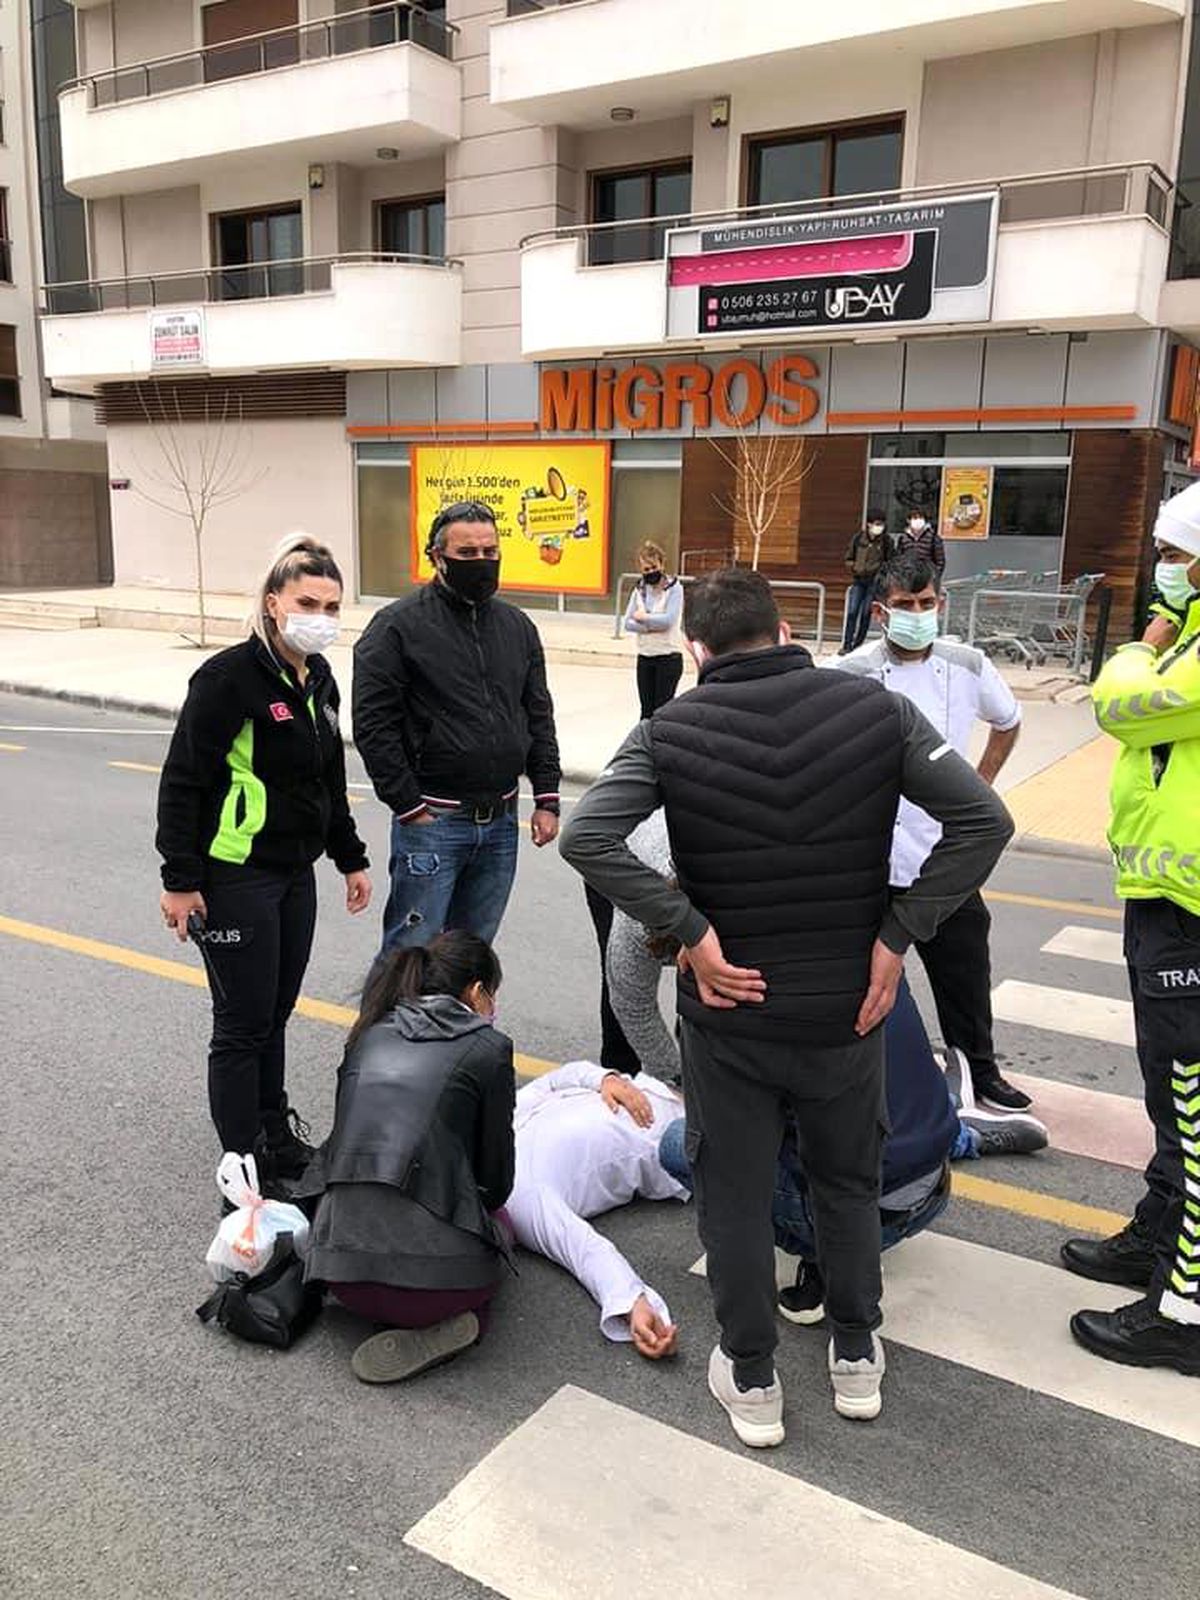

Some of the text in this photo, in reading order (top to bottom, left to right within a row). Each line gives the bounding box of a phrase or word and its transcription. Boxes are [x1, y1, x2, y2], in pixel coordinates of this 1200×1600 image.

[756, 292, 780, 306] 235
[825, 282, 905, 319] UBAY
[426, 476, 444, 488] Her
[1157, 968, 1200, 988] TRA
